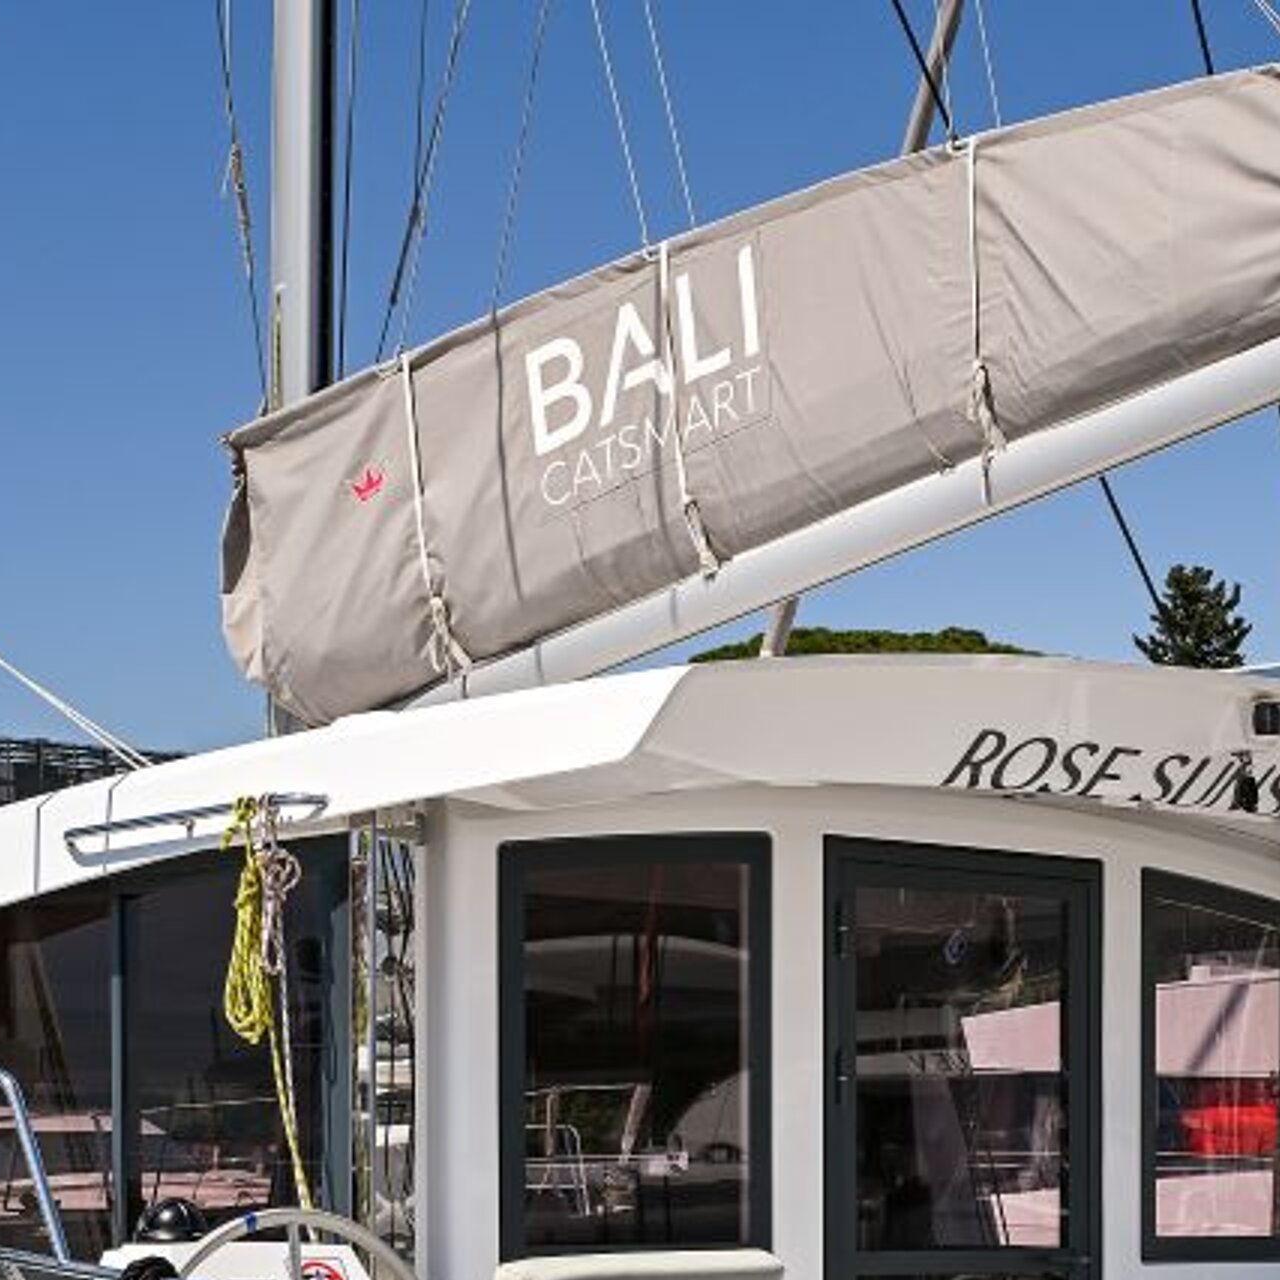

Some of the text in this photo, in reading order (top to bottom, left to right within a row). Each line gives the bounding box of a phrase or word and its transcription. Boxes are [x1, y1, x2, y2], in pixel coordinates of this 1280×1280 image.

[525, 244, 761, 456] BALI
[540, 366, 762, 505] CATSMART
[941, 727, 1142, 799] ROSE
